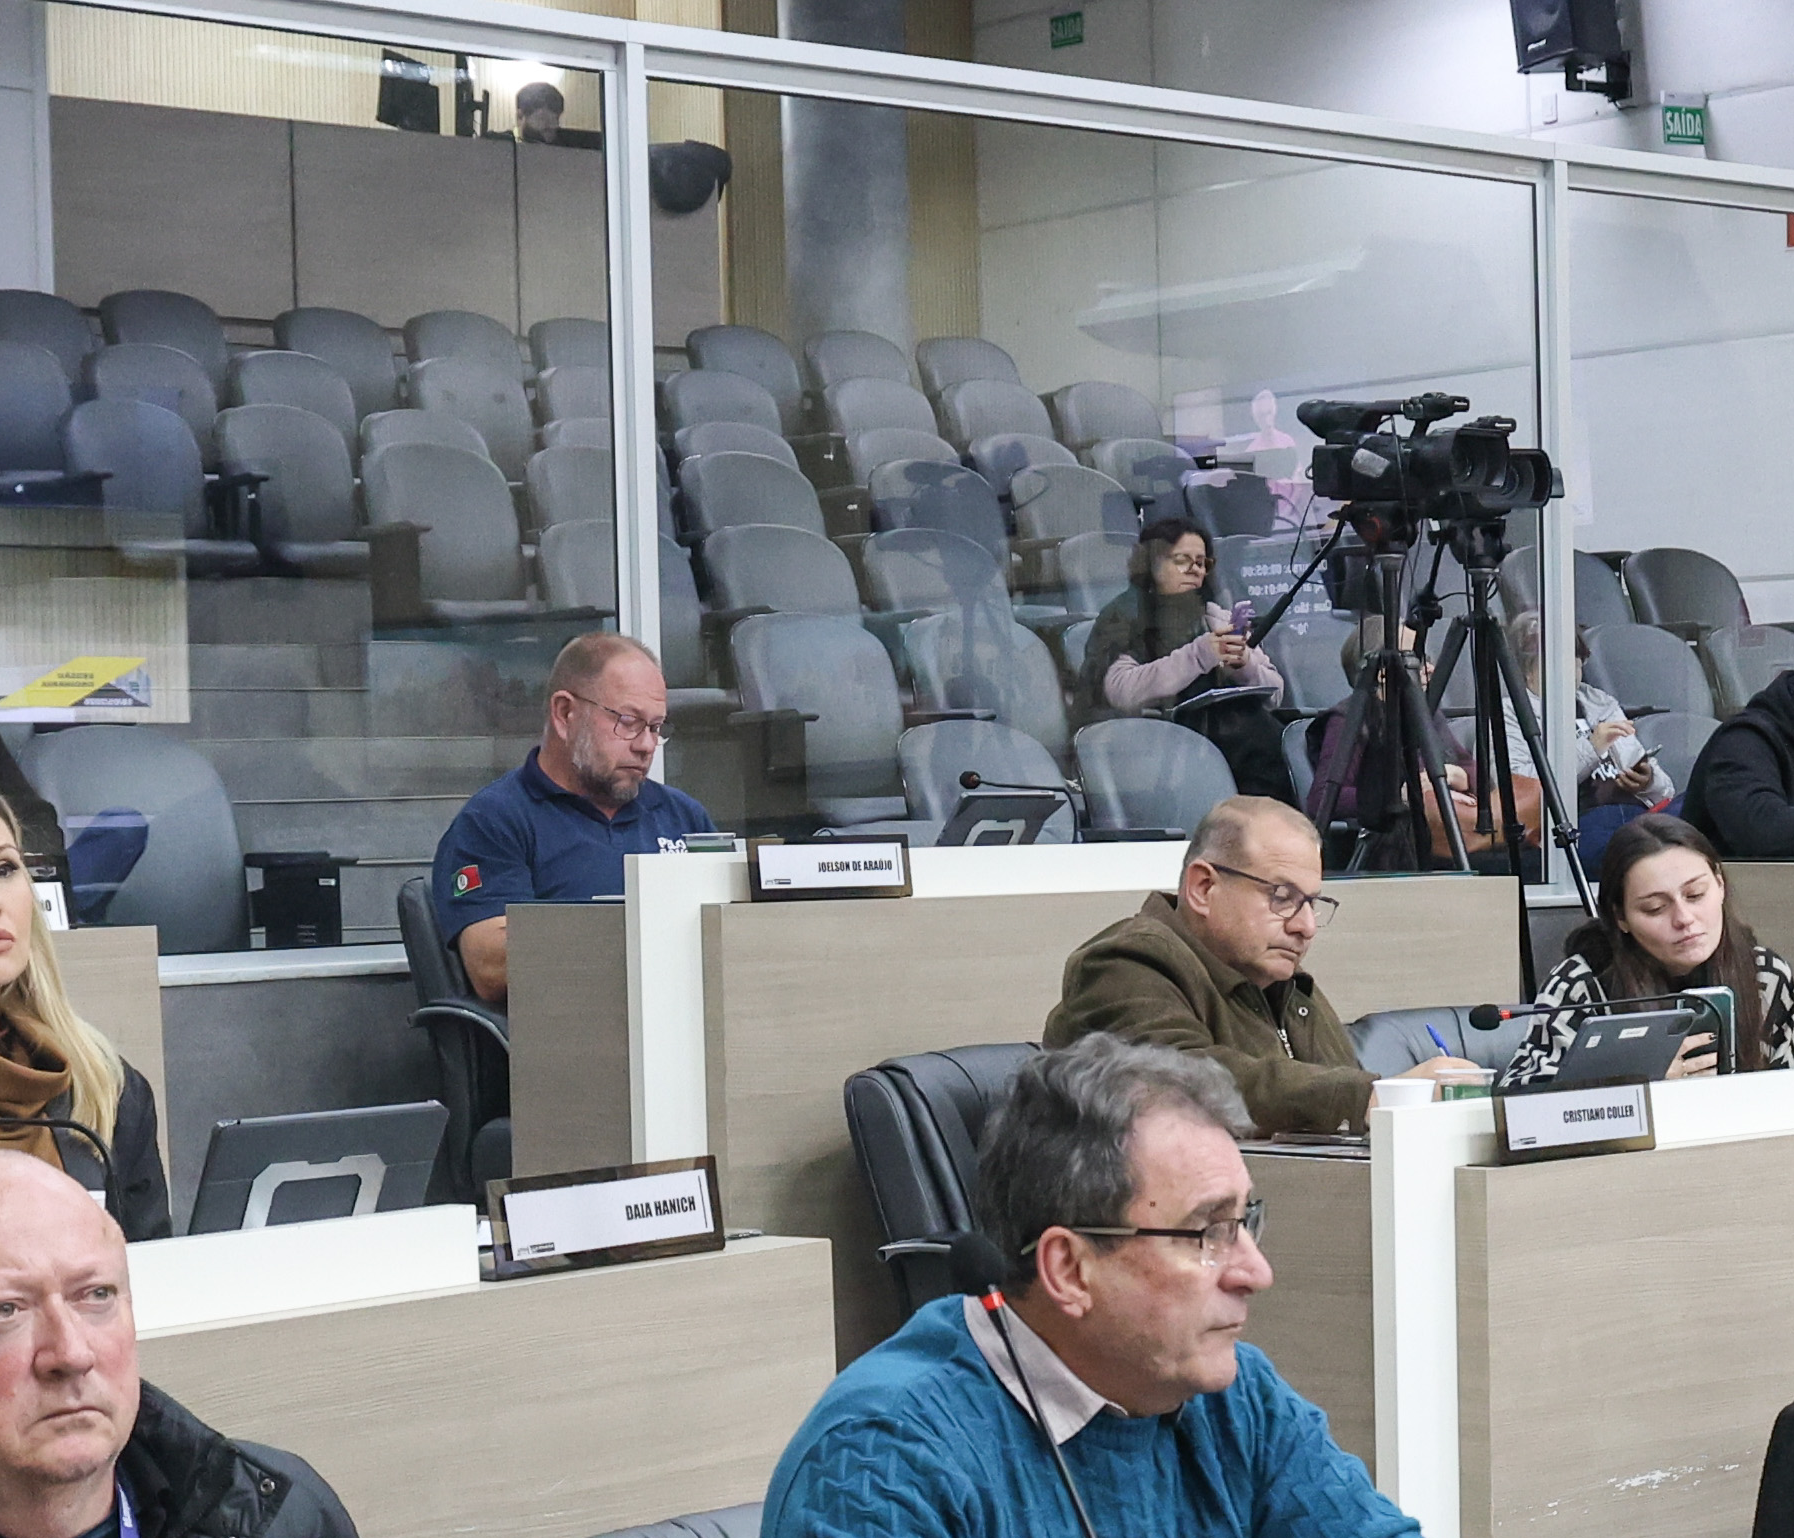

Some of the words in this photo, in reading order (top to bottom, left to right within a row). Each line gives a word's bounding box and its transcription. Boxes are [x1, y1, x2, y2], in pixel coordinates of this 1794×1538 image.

[1665, 107, 1703, 136] SAÍDA
[818, 861, 851, 873] JOELSON
[852, 860, 863, 872] DE
[863, 858, 893, 871] ARAÚJO
[1563, 1107, 1606, 1124] CRISTIANO
[1607, 1104, 1635, 1120] COLLER
[625, 1202, 653, 1221] DAIA
[654, 1196, 696, 1216] HANICH
